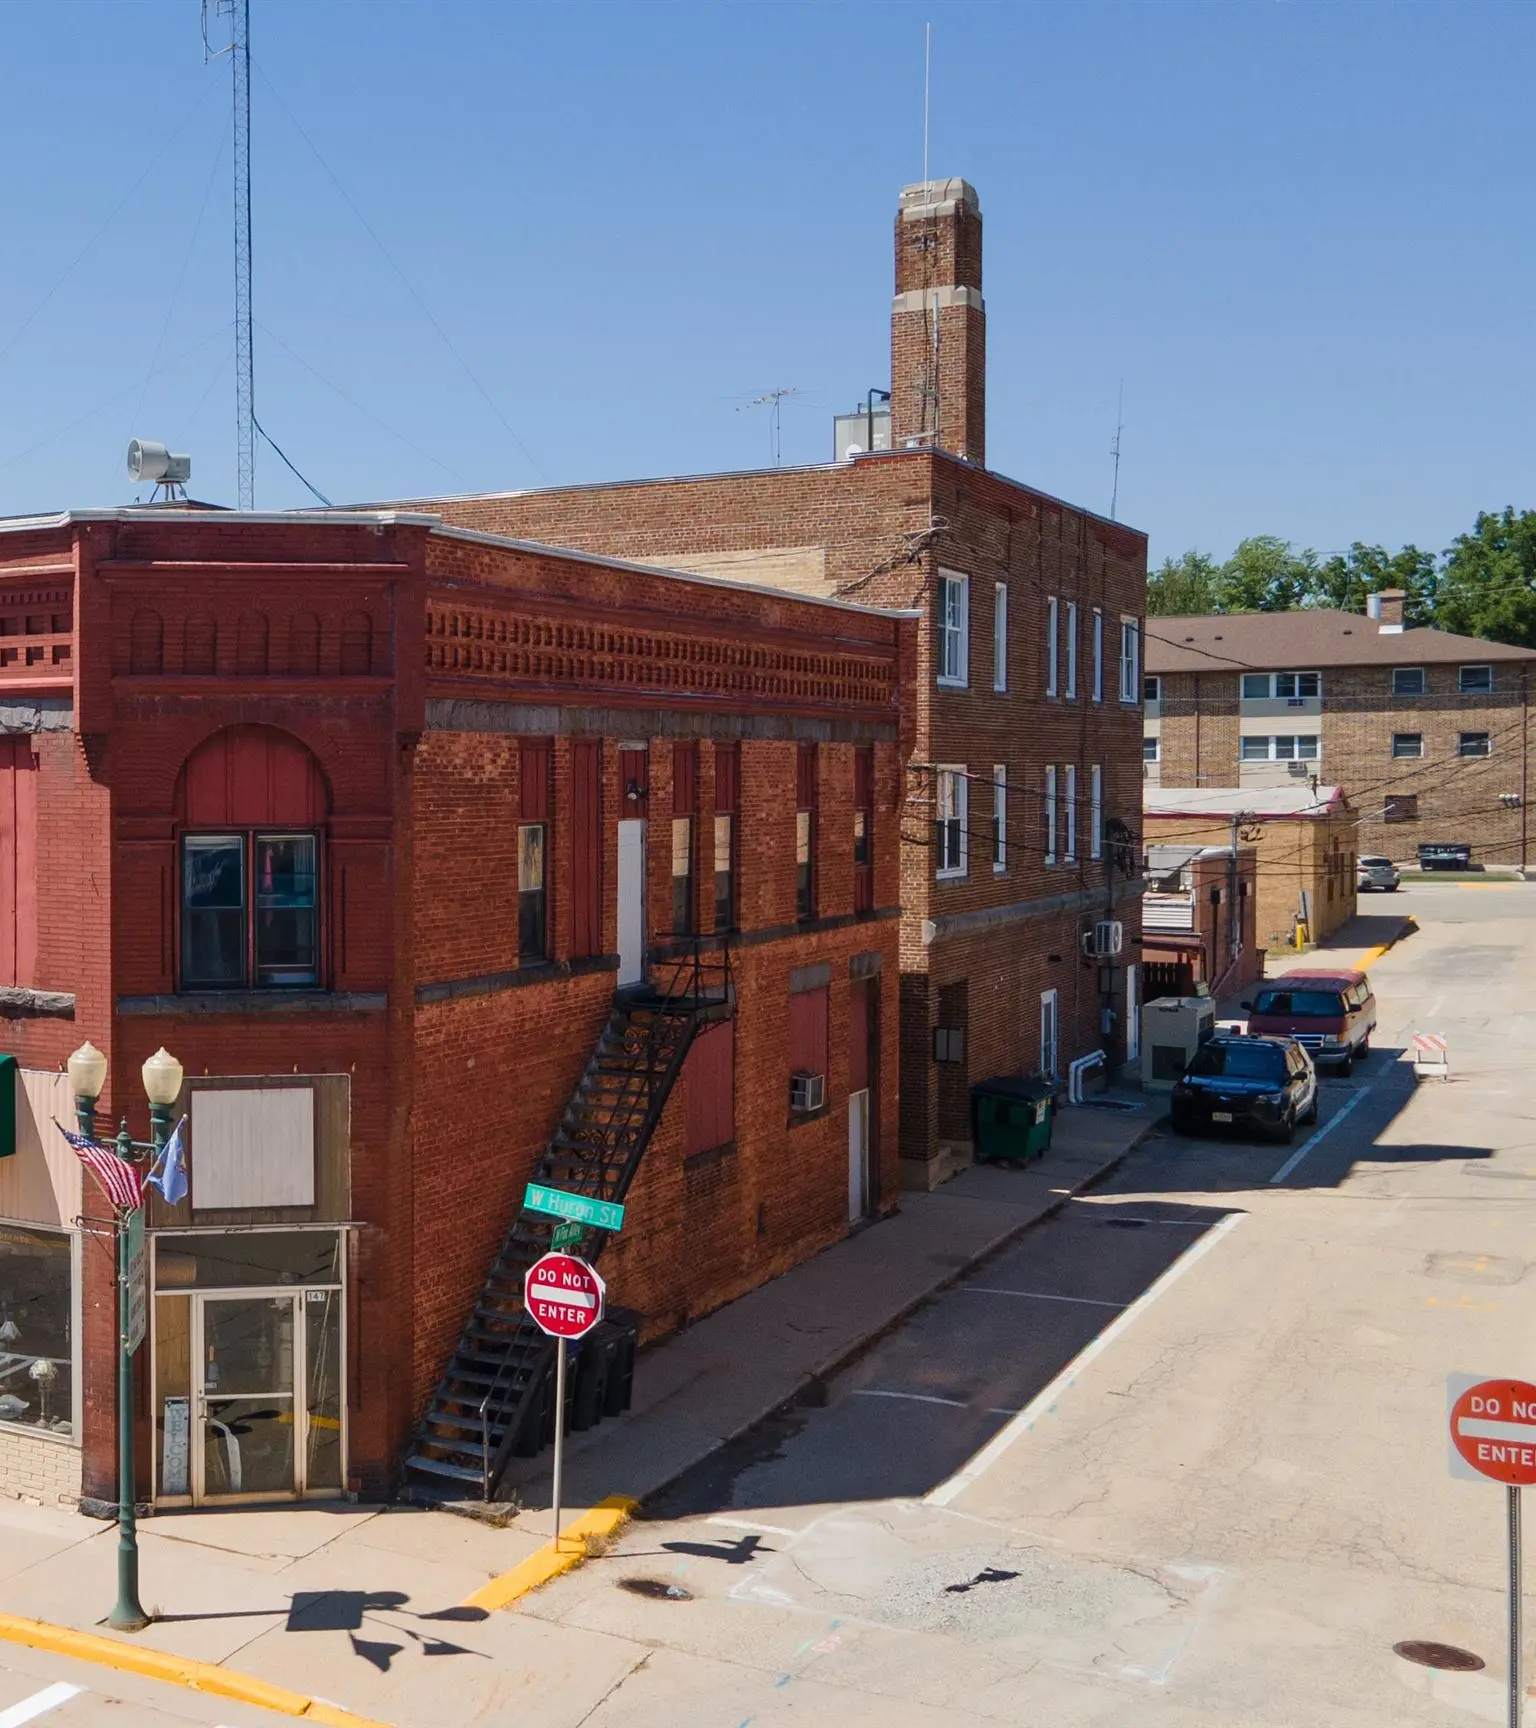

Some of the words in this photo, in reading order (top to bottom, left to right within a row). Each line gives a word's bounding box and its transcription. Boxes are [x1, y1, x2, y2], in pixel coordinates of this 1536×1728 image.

[530, 1188, 544, 1206] W
[547, 1192, 594, 1219] Huron
[600, 1206, 617, 1225] St
[538, 1268, 556, 1283] DO
[562, 1272, 590, 1289] NOT
[538, 1303, 586, 1325] ENTER
[1470, 1396, 1501, 1415] DO
[1477, 1443, 1536, 1467] ENTE
